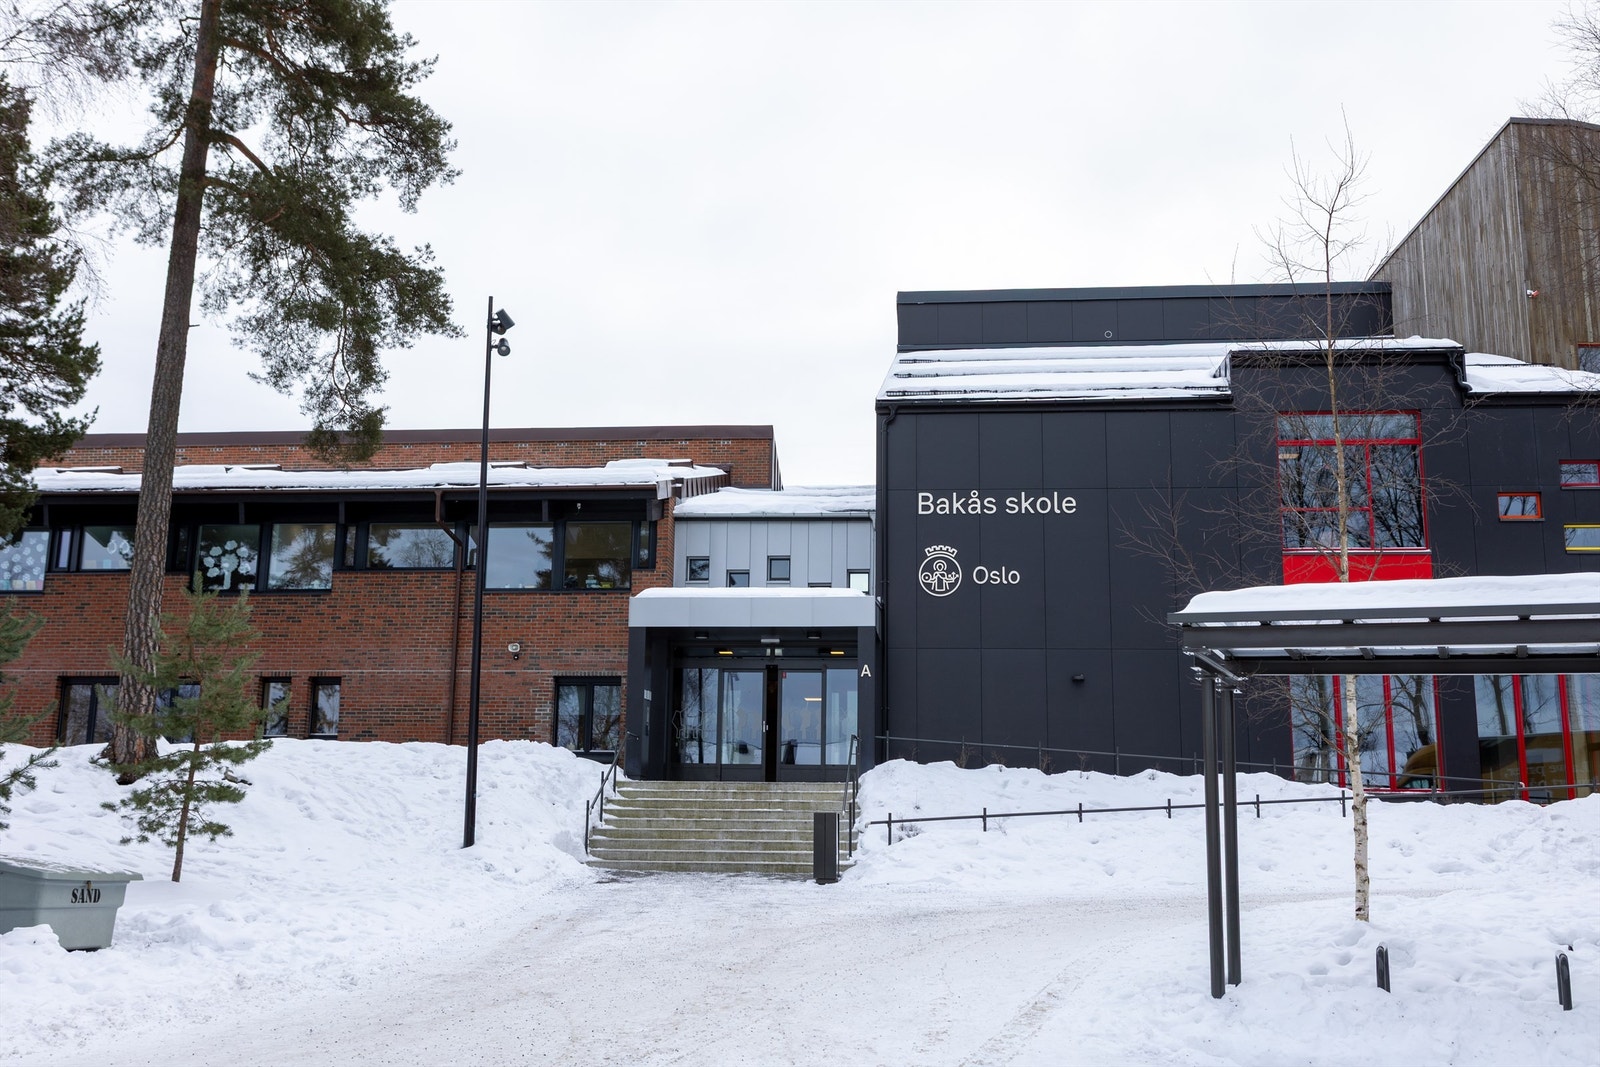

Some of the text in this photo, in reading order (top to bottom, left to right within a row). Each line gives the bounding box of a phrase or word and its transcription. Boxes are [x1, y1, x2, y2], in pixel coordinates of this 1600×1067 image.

[918, 490, 1077, 515] Bakås skole
[972, 566, 1020, 585] Oslo
[860, 664, 872, 678] A
[70, 887, 102, 904] SAND
